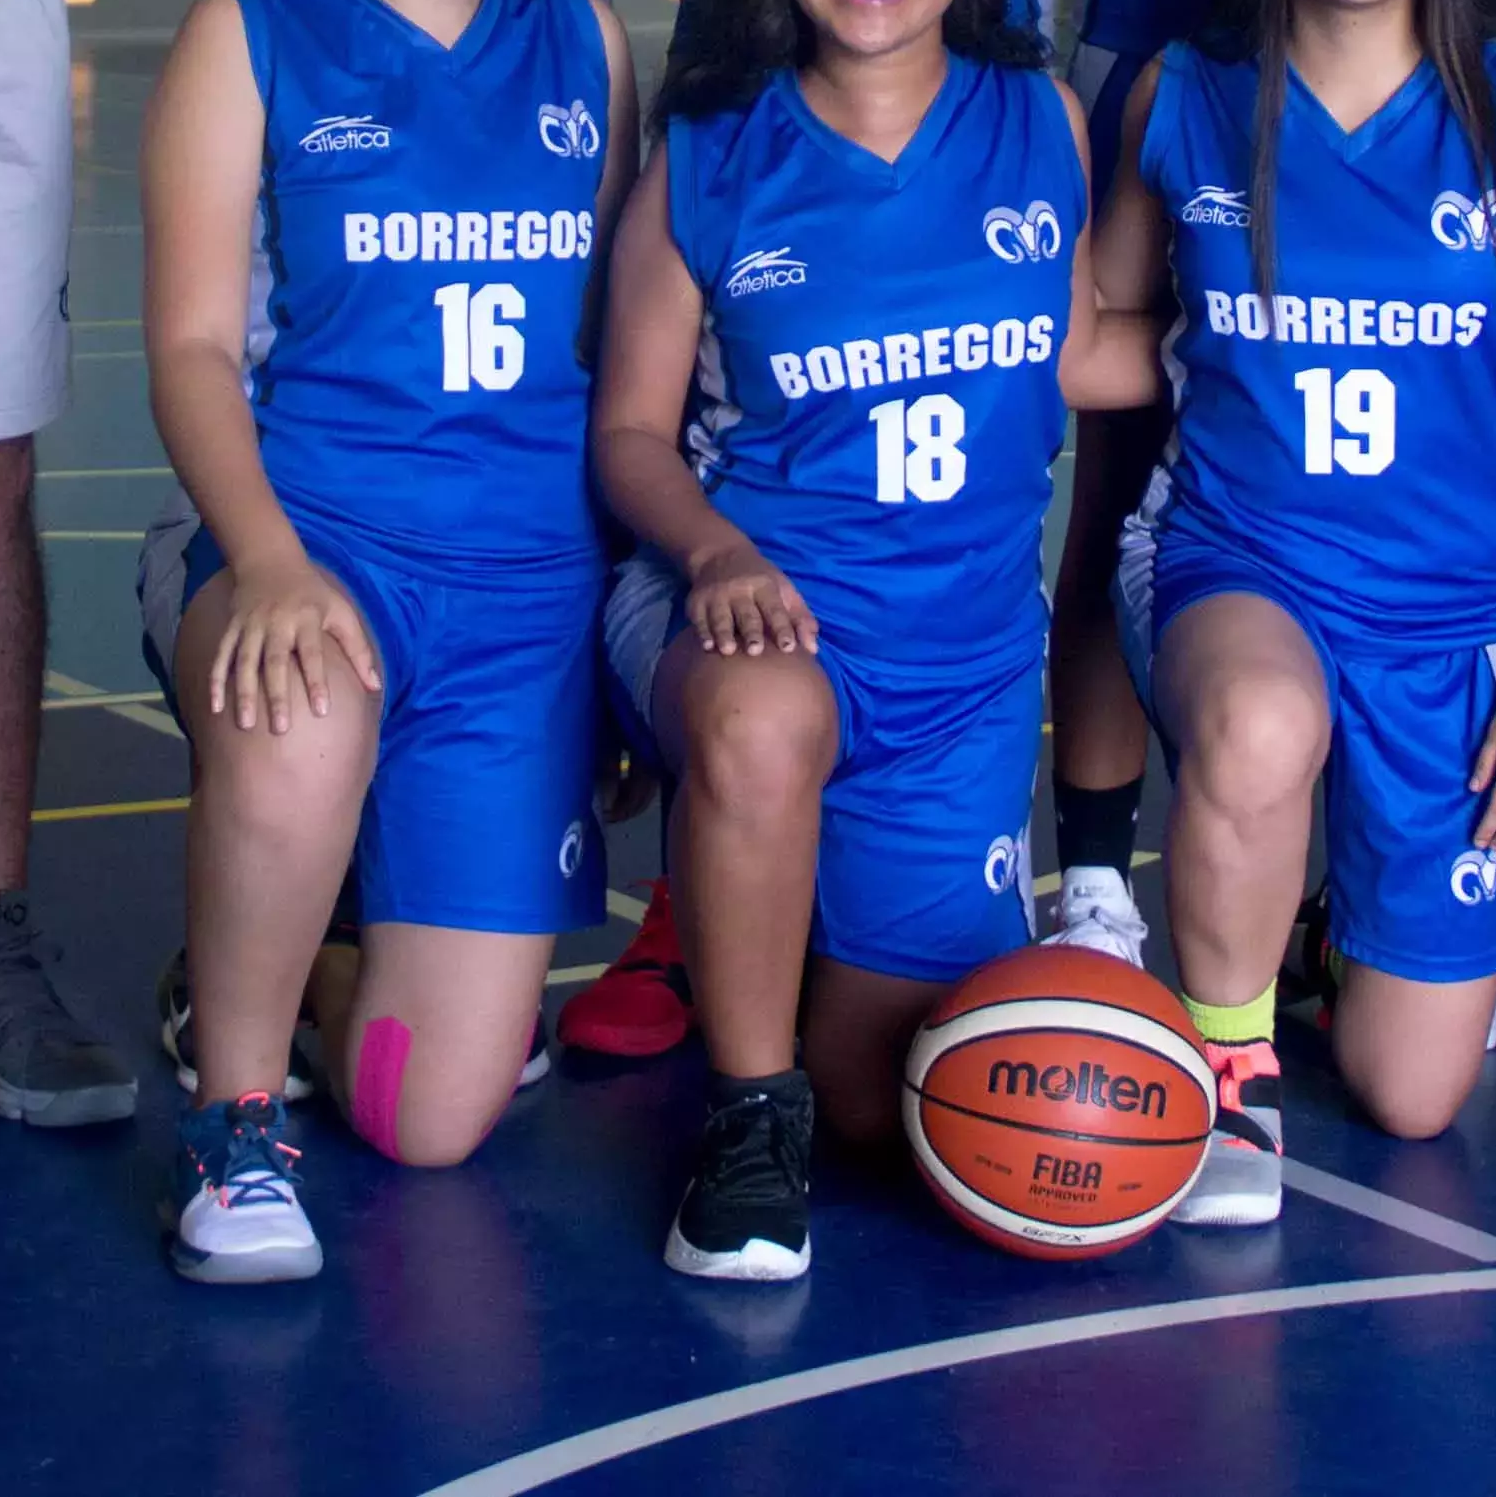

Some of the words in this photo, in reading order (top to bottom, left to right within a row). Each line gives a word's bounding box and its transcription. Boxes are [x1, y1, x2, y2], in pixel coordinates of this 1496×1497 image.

[305, 127, 391, 153] atletica
[344, 210, 594, 263] BORREGOS
[1182, 204, 1252, 228] atletica
[730, 264, 807, 298] atletica
[433, 282, 527, 393] 16
[1204, 289, 1488, 347] BORREGOS
[770, 314, 1055, 400] BORREGOS
[868, 393, 967, 504] 18
[1294, 367, 1396, 477] 19
[988, 1059, 1167, 1119] molten
[1033, 1152, 1102, 1190] FIBA
